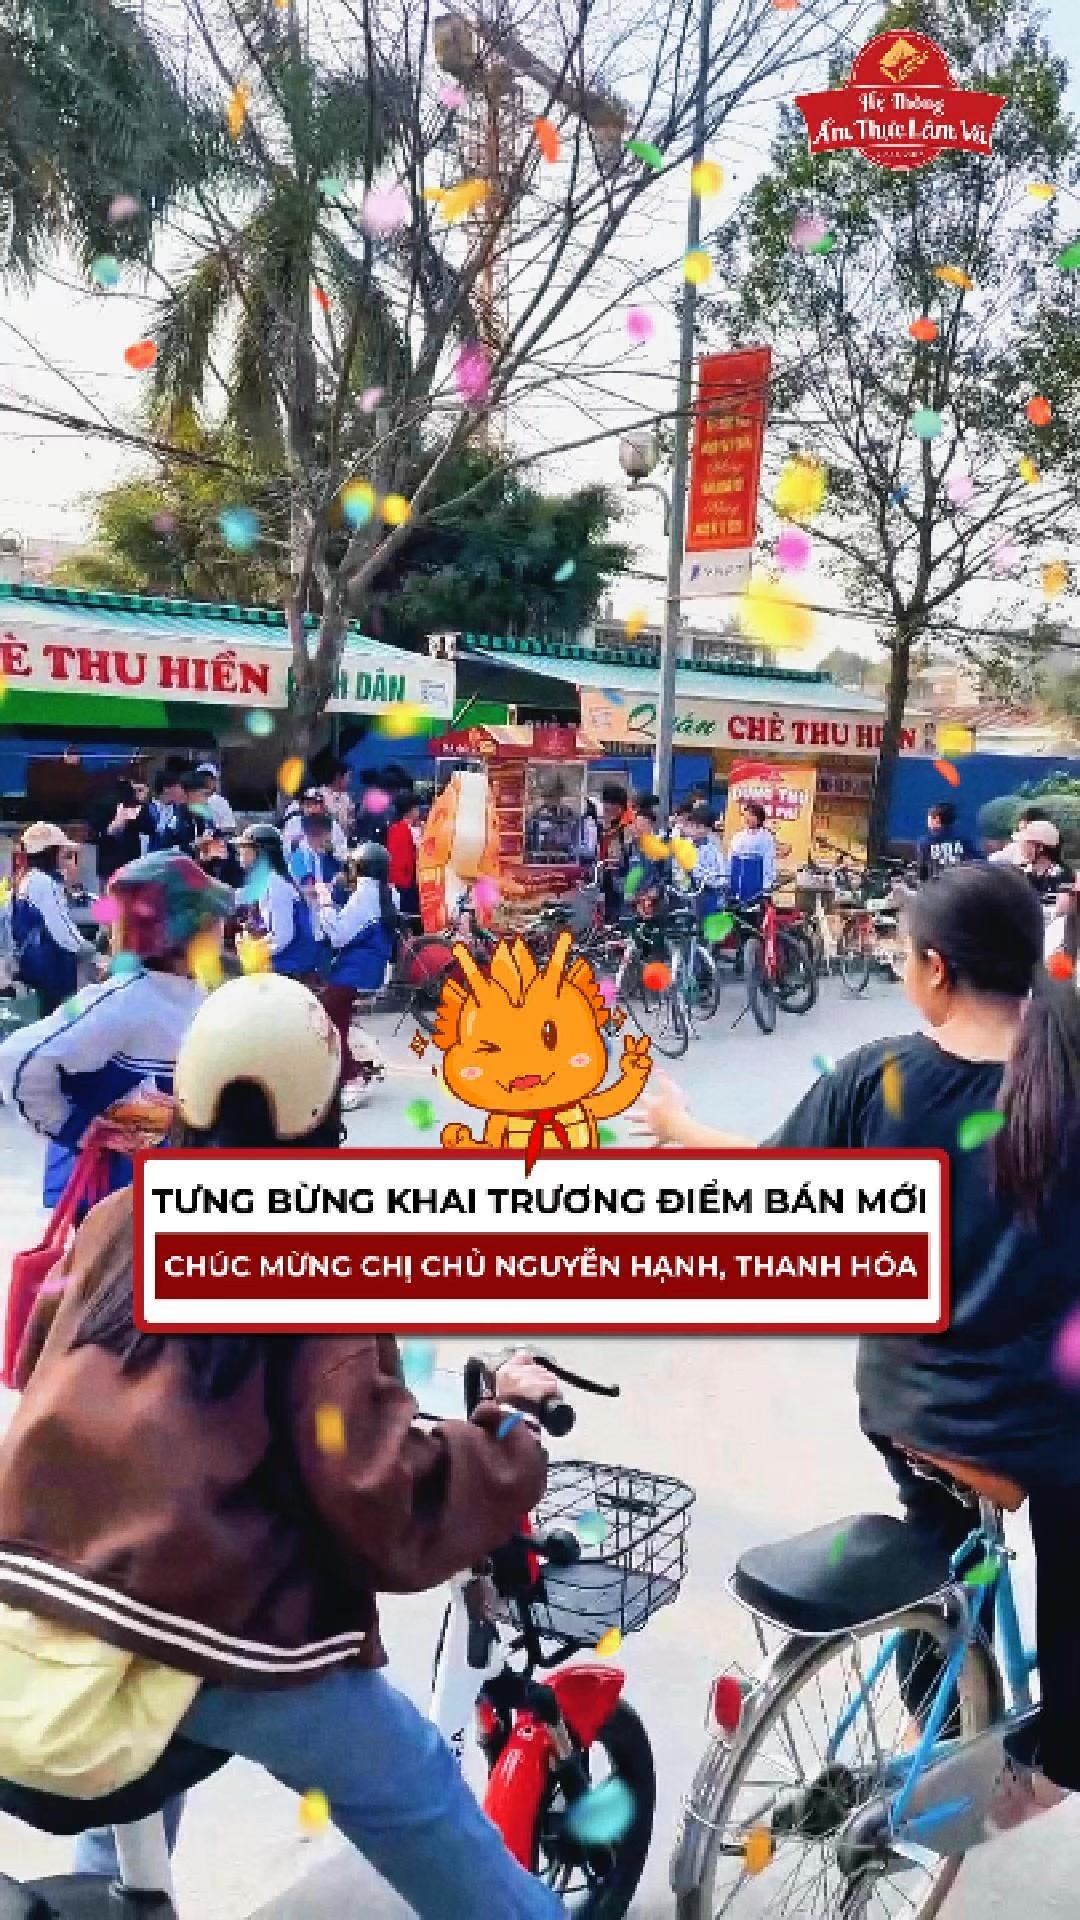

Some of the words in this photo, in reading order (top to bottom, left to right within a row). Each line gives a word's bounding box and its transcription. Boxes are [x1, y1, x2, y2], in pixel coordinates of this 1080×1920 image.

[42, 644, 147, 686] THU
[356, 666, 406, 703] DÂN
[727, 711, 784, 742] CHÈ
[791, 720, 849, 745] THU
[855, 724, 917, 749] HIN
